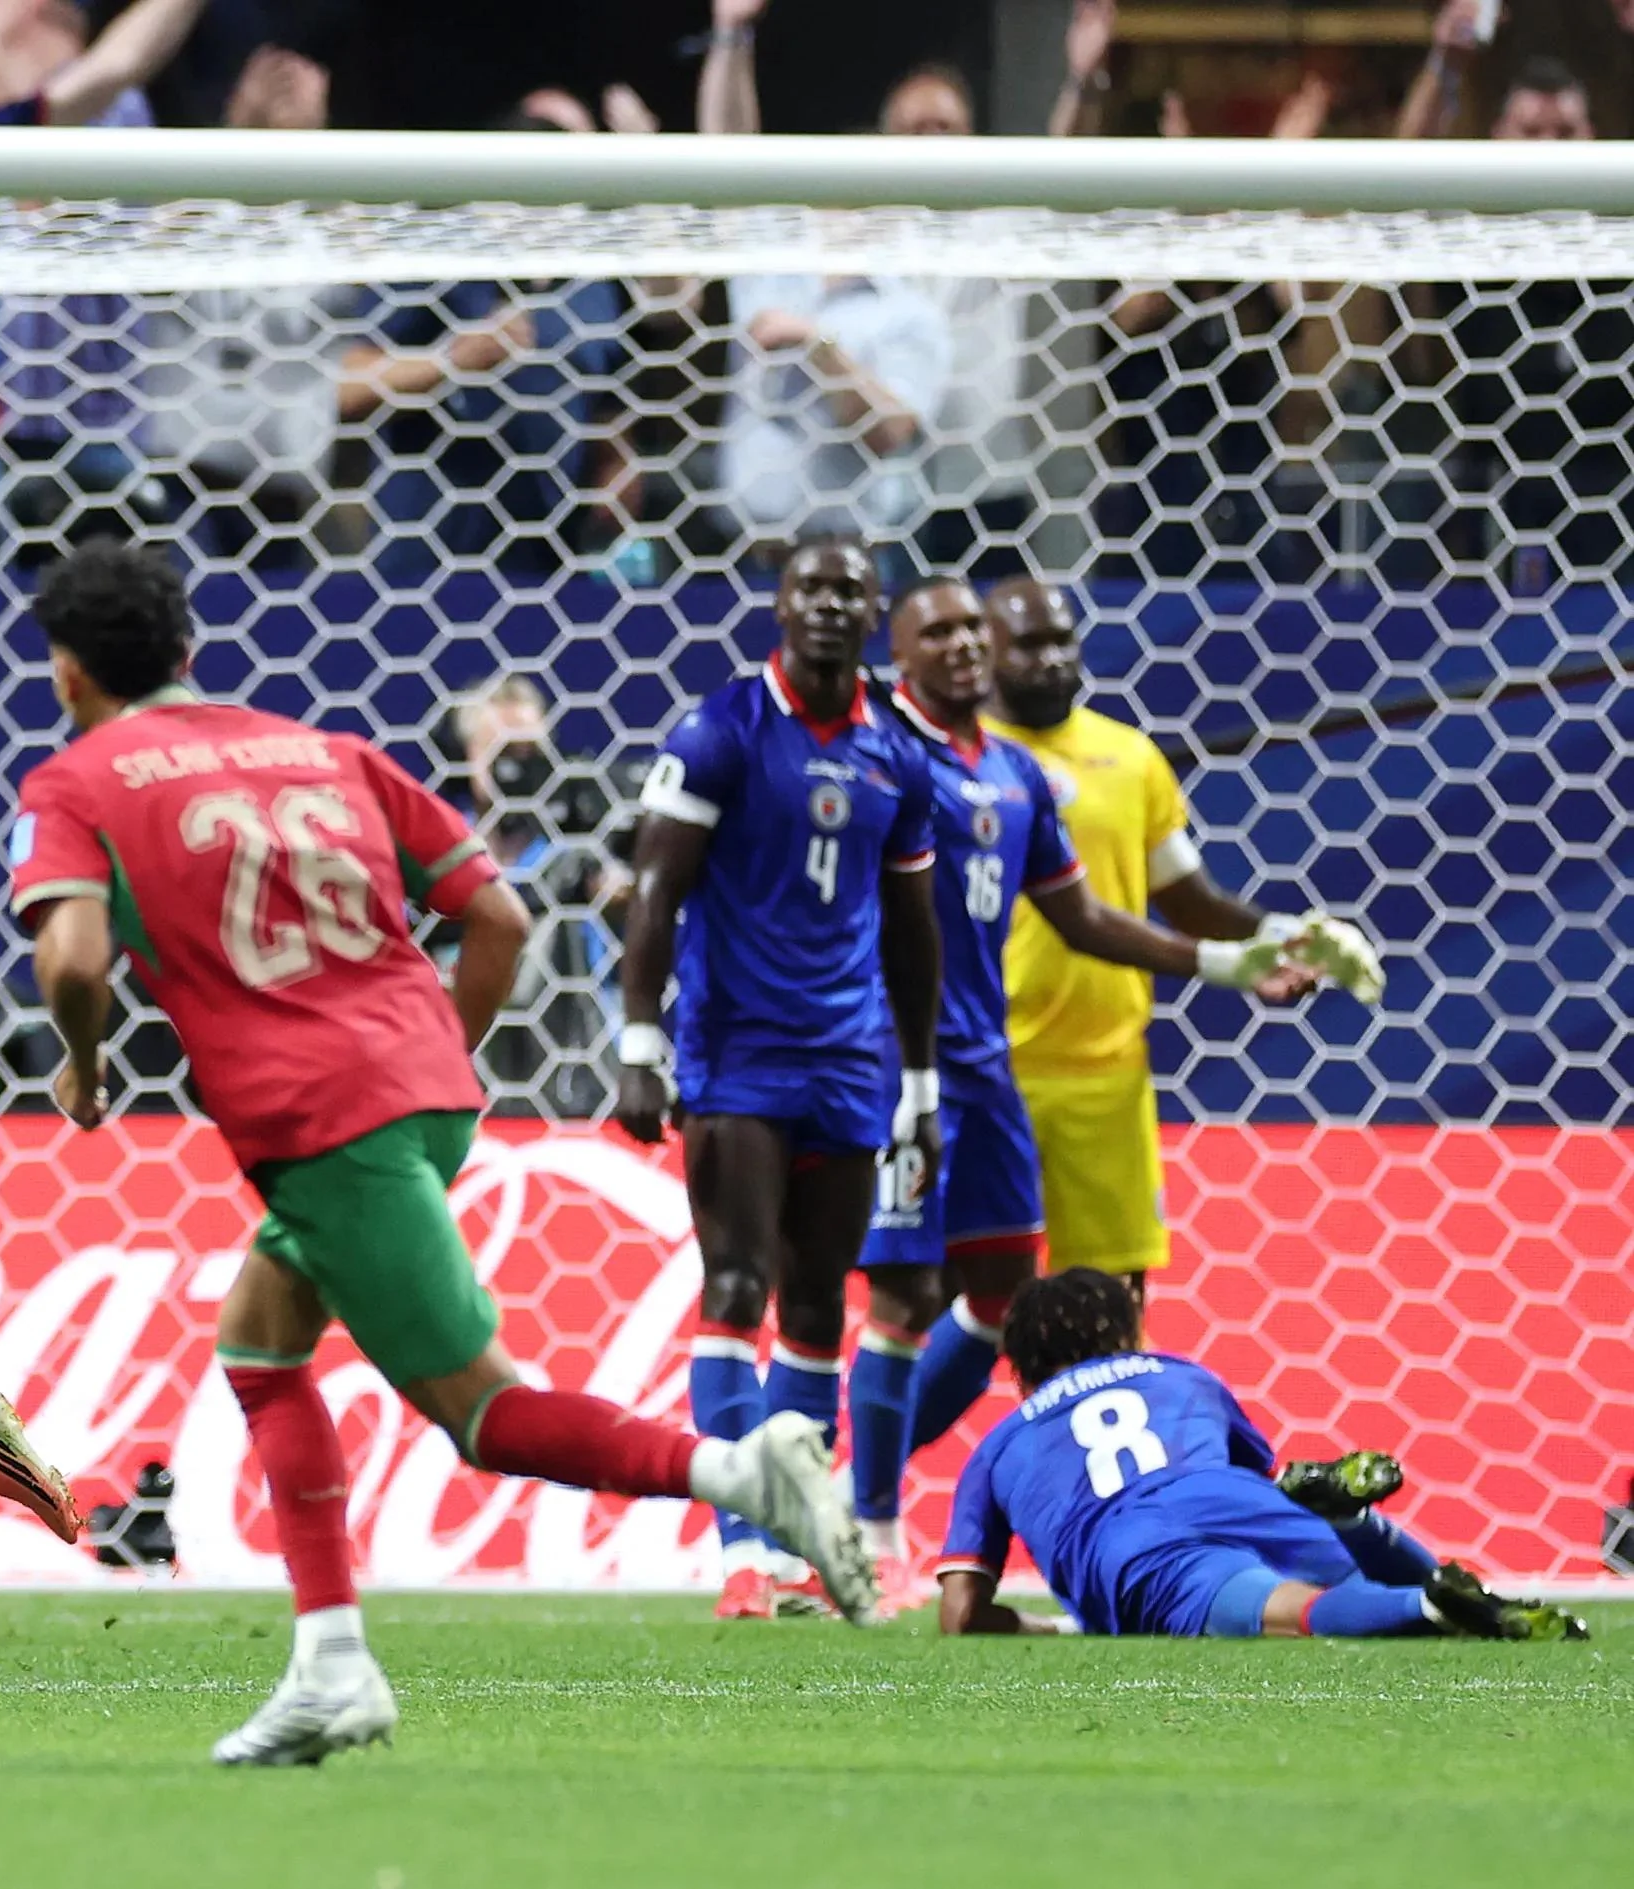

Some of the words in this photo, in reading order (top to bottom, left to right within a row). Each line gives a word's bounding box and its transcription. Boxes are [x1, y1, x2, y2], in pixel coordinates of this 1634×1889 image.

[178, 784, 388, 991] 26
[805, 834, 839, 904] 4
[964, 852, 1004, 923] 16
[1070, 1388, 1169, 1499] 8
